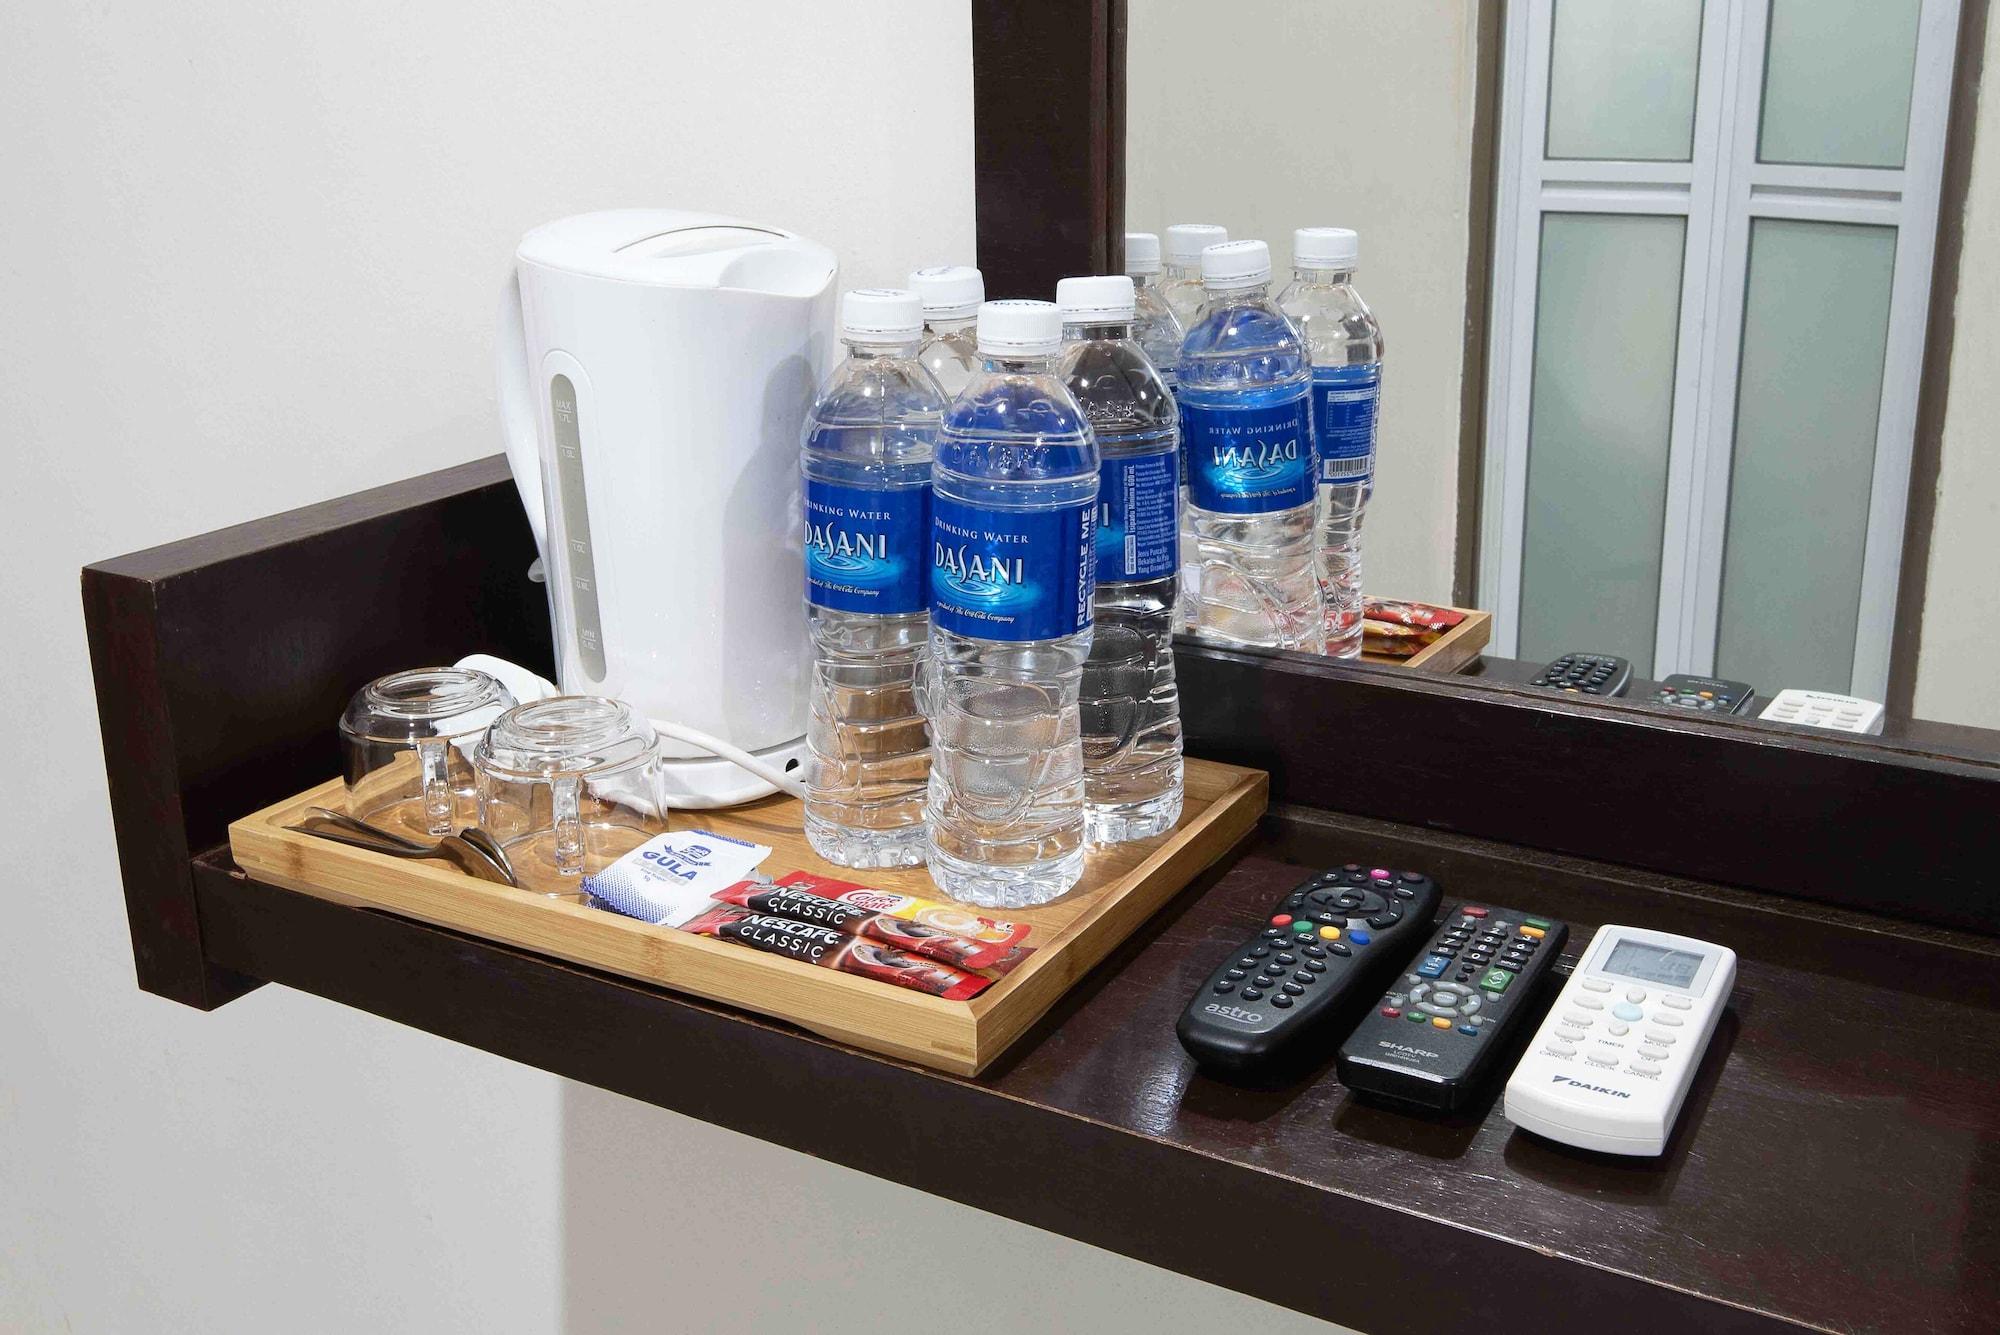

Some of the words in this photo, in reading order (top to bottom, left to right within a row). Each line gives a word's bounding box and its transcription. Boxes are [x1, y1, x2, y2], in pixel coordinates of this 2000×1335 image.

[849, 509, 891, 520] WATER
[1081, 509, 1091, 539] ME
[804, 521, 887, 559] DASANI
[935, 517, 978, 540] DRINKING
[984, 532, 1029, 544] WATER
[935, 541, 1024, 585] DASANI
[1077, 543, 1089, 627] RECYCLE
[643, 851, 697, 880] GULA
[847, 892, 901, 903] Coffee
[768, 897, 846, 924] CLASSIC
[740, 926, 824, 958] CLASSIC
[1471, 952, 1481, 960] 0
[1501, 960, 1517, 968] INPUT
[1205, 1003, 1262, 1022] astro
[1378, 1041, 1440, 1058] SHARP
[1598, 1039, 1625, 1049] TIMER
[1539, 1050, 1573, 1061] CANCEL
[1623, 1069, 1660, 1081] CANCEL
[1568, 1080, 1631, 1099] DAIKIN
